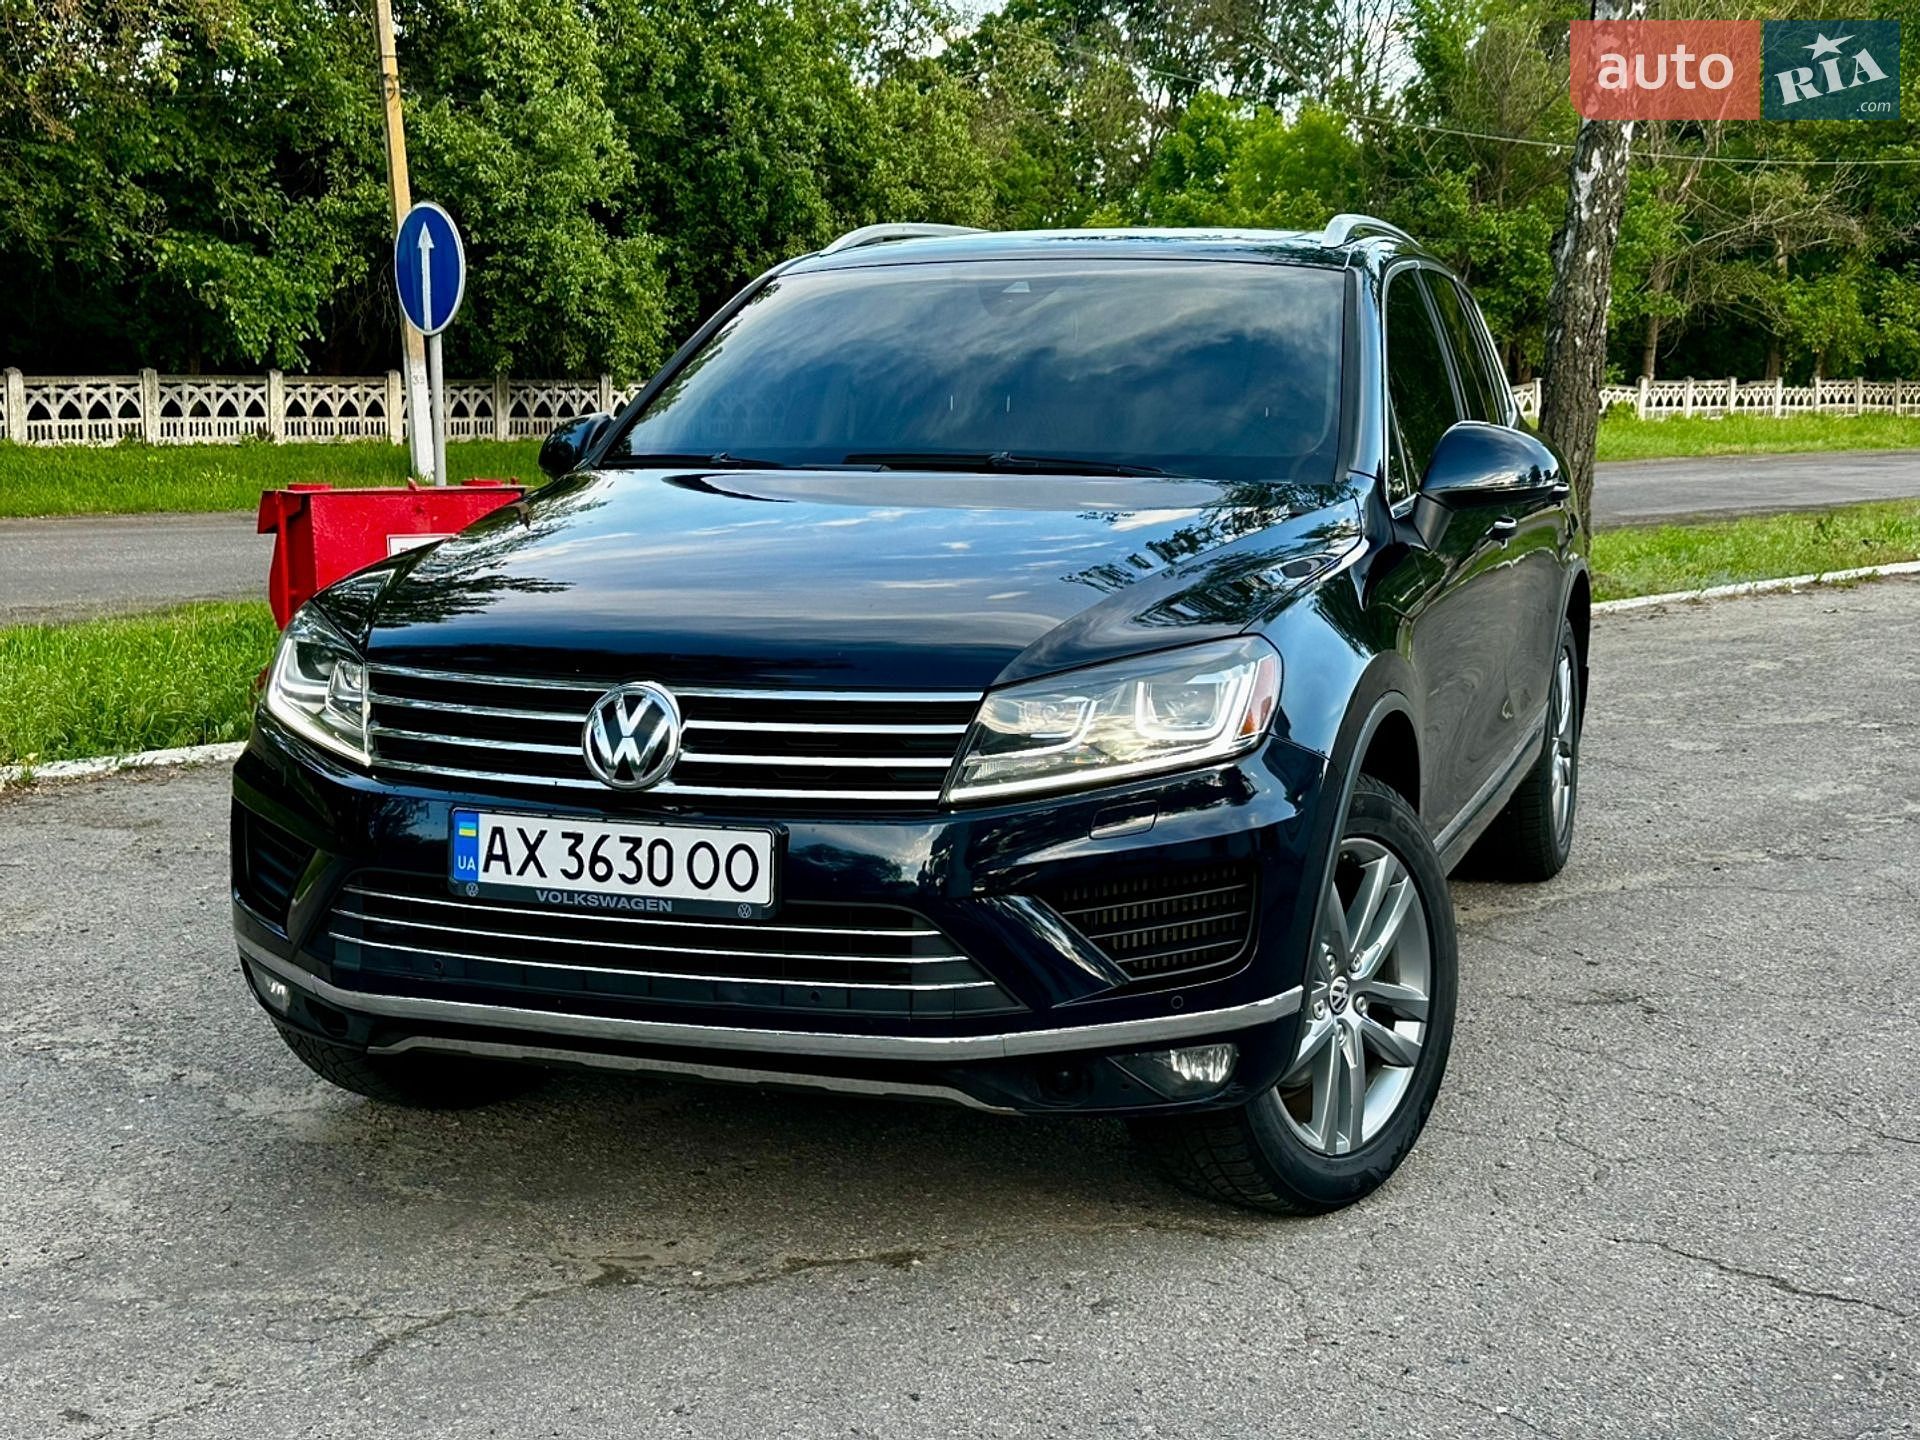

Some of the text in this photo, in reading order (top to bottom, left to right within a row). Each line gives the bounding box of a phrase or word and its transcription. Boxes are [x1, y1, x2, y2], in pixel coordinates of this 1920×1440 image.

[457, 855, 477, 873] UA
[482, 825, 760, 893] AX 3630 OO
[536, 889, 673, 913] VOLKSWAGEN
